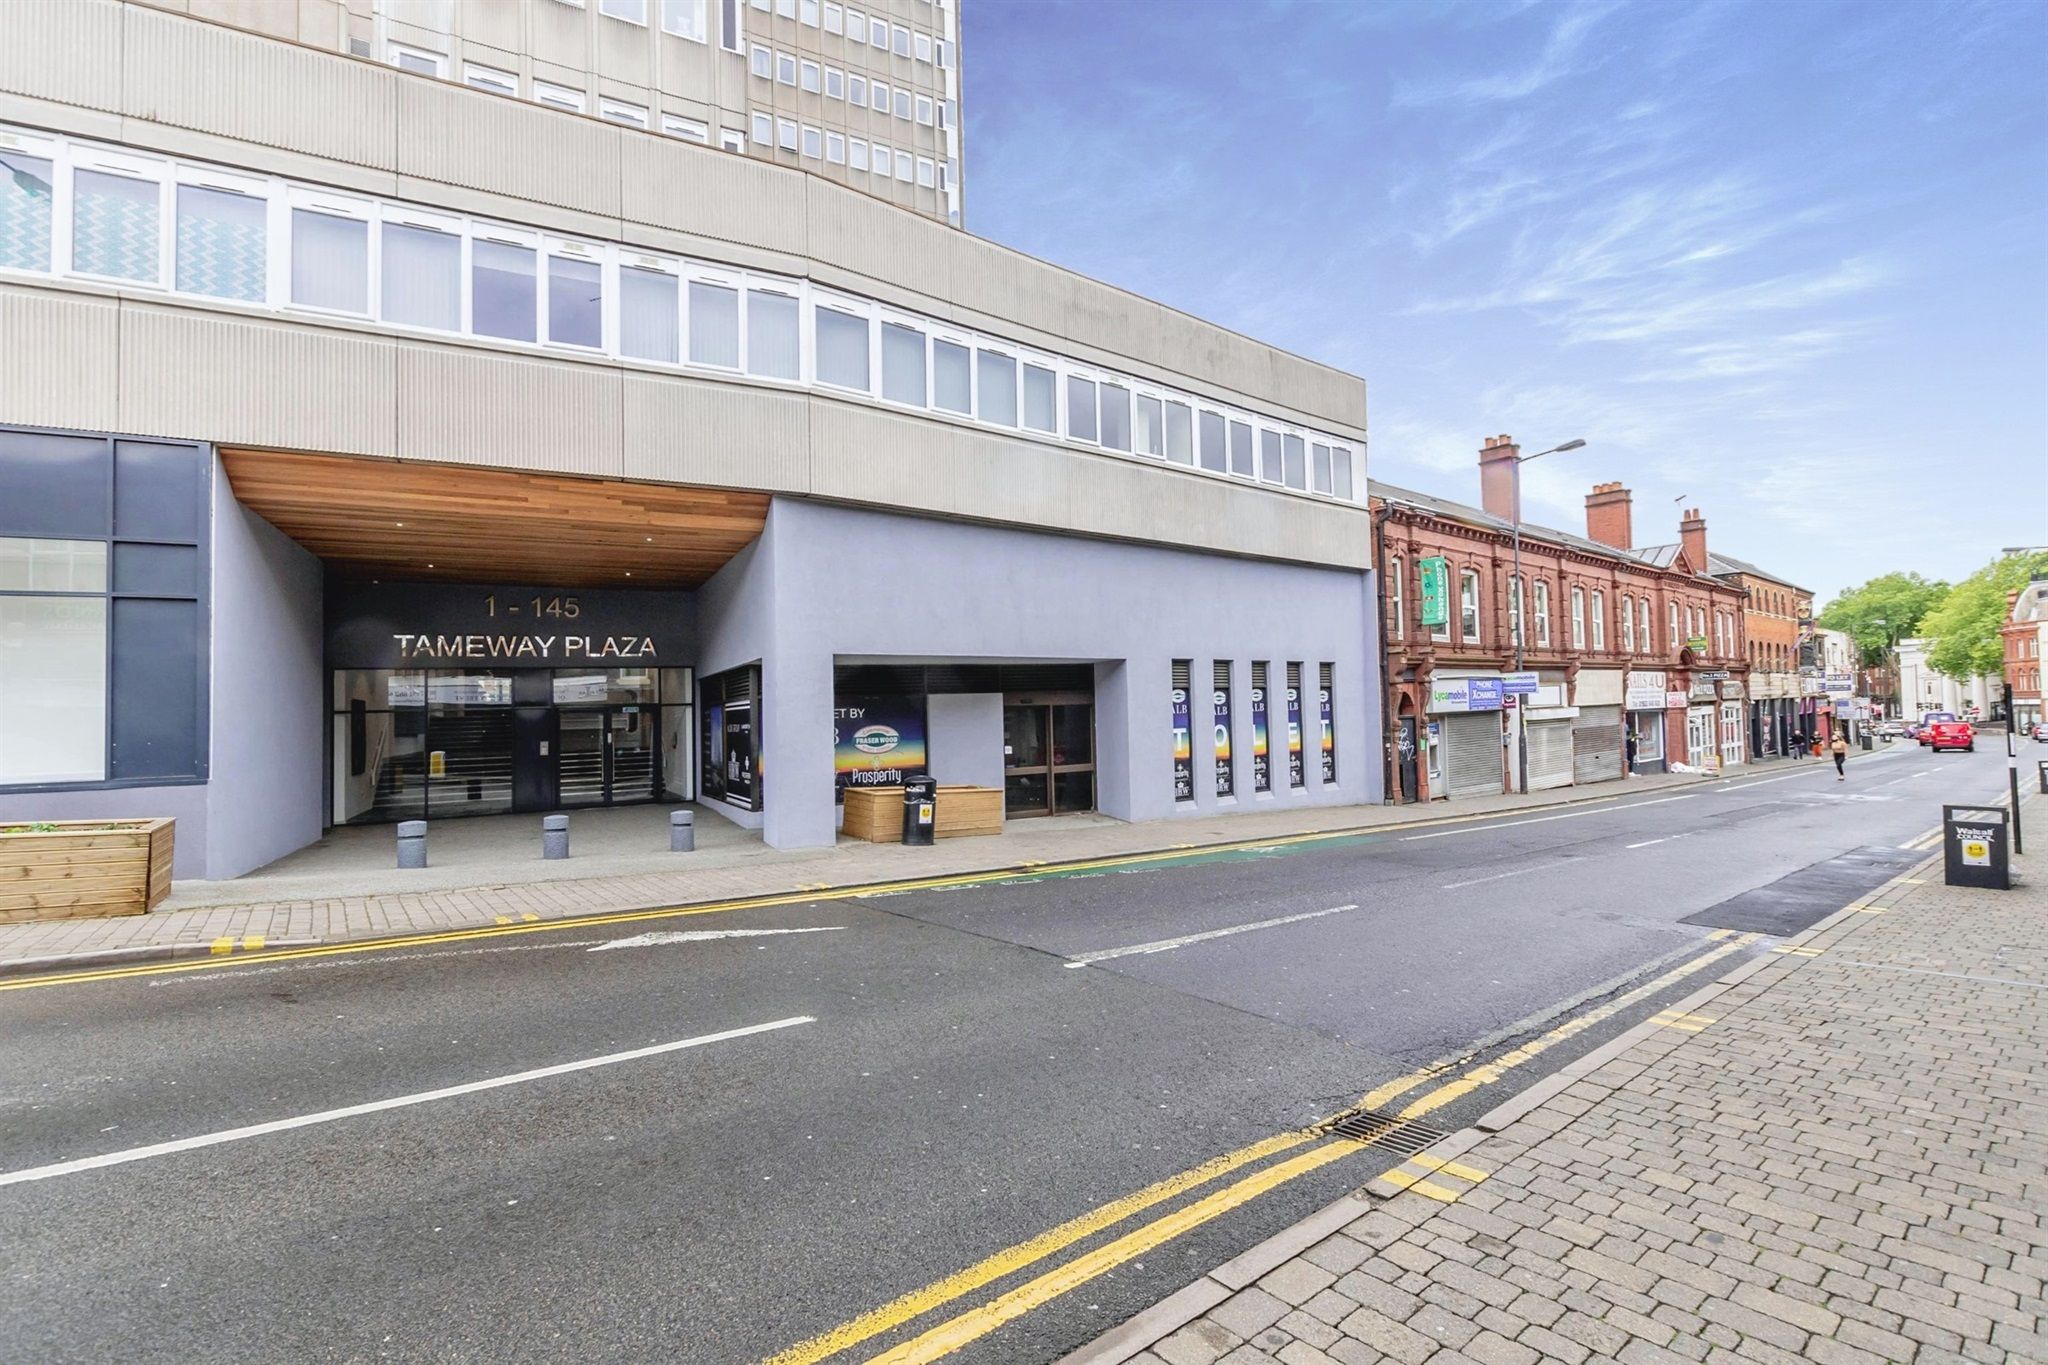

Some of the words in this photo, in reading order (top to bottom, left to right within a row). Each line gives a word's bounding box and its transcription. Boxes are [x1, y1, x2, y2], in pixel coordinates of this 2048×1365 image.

[485, 595, 495, 617] 1
[531, 597, 580, 618] 145
[393, 634, 556, 657] TAMEWAY
[565, 635, 657, 657] PLAZA
[850, 708, 865, 718] BY
[853, 768, 901, 784] Prosperity
